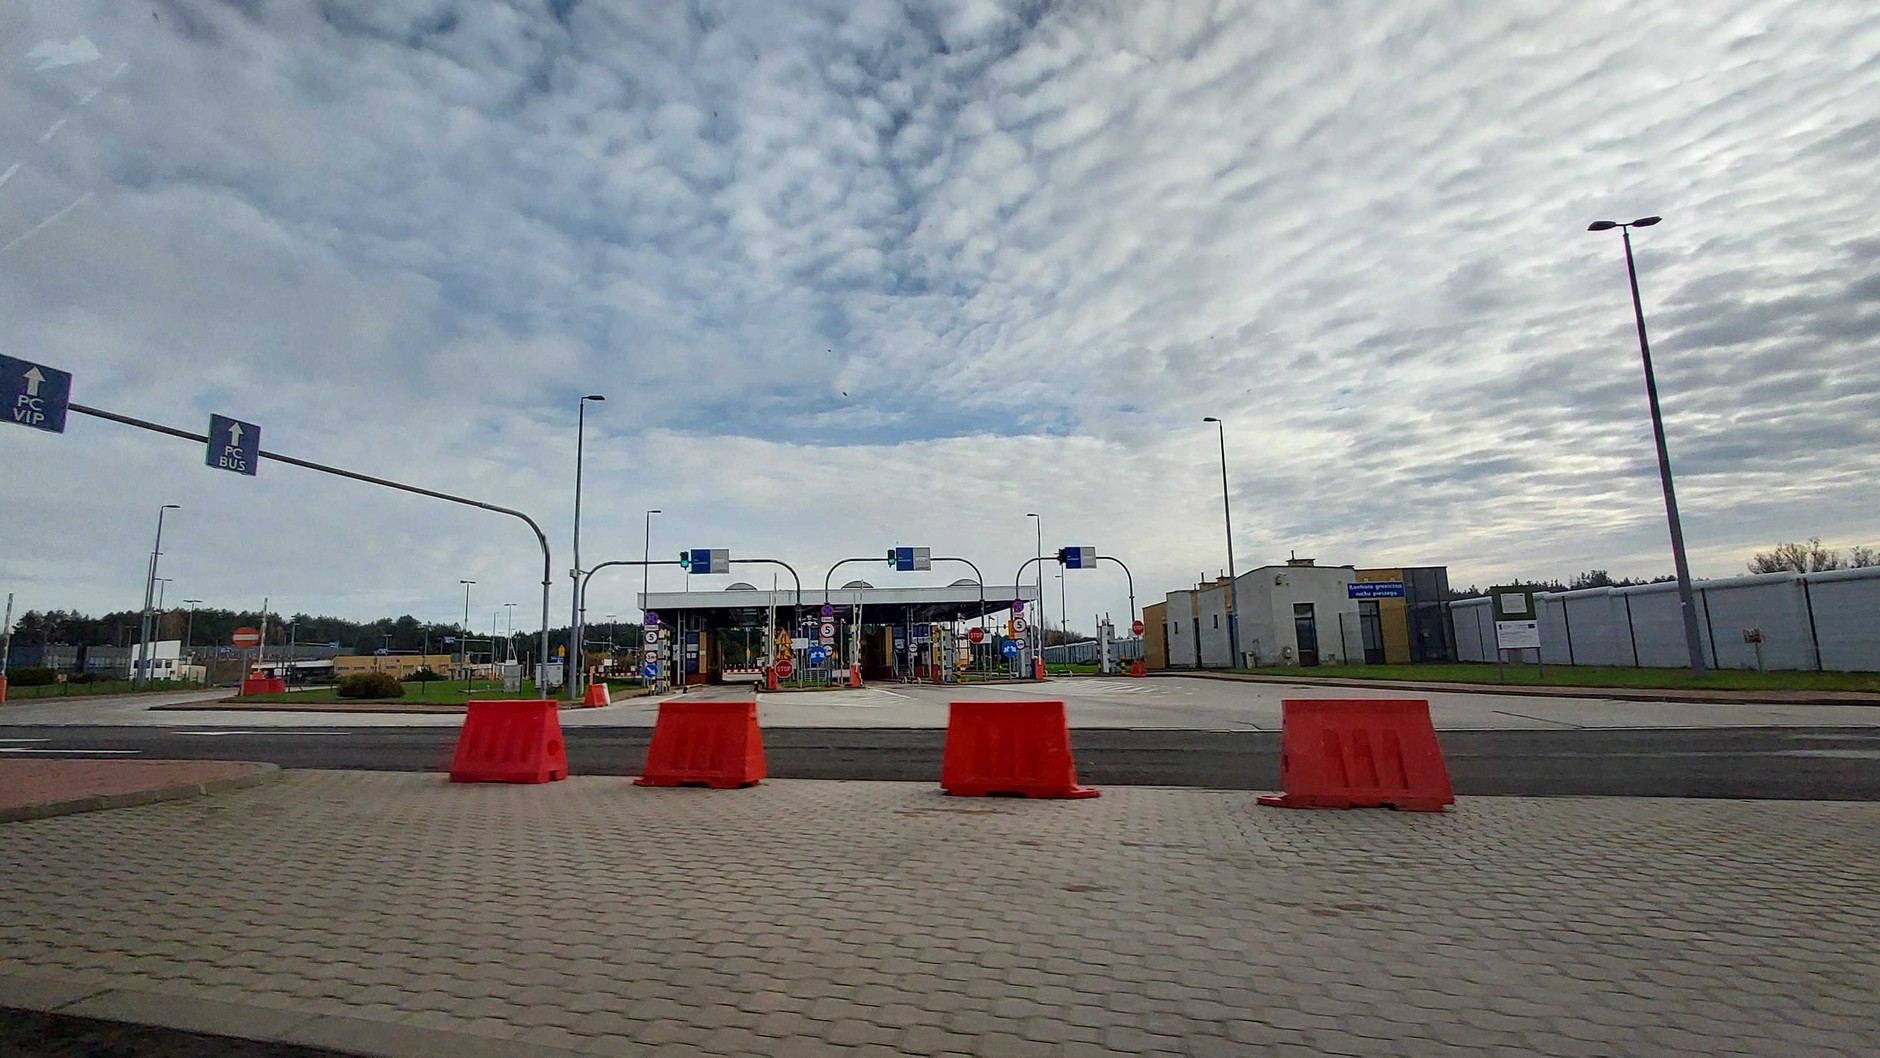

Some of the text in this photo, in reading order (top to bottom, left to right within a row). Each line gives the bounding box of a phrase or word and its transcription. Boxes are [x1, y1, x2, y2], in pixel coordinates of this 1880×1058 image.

[17, 394, 44, 411] PC
[12, 407, 45, 424] VIP
[225, 445, 243, 459] PC
[219, 456, 246, 471] BUS
[824, 626, 831, 634] 5
[1016, 621, 1023, 629] 5
[649, 633, 654, 641] 5
